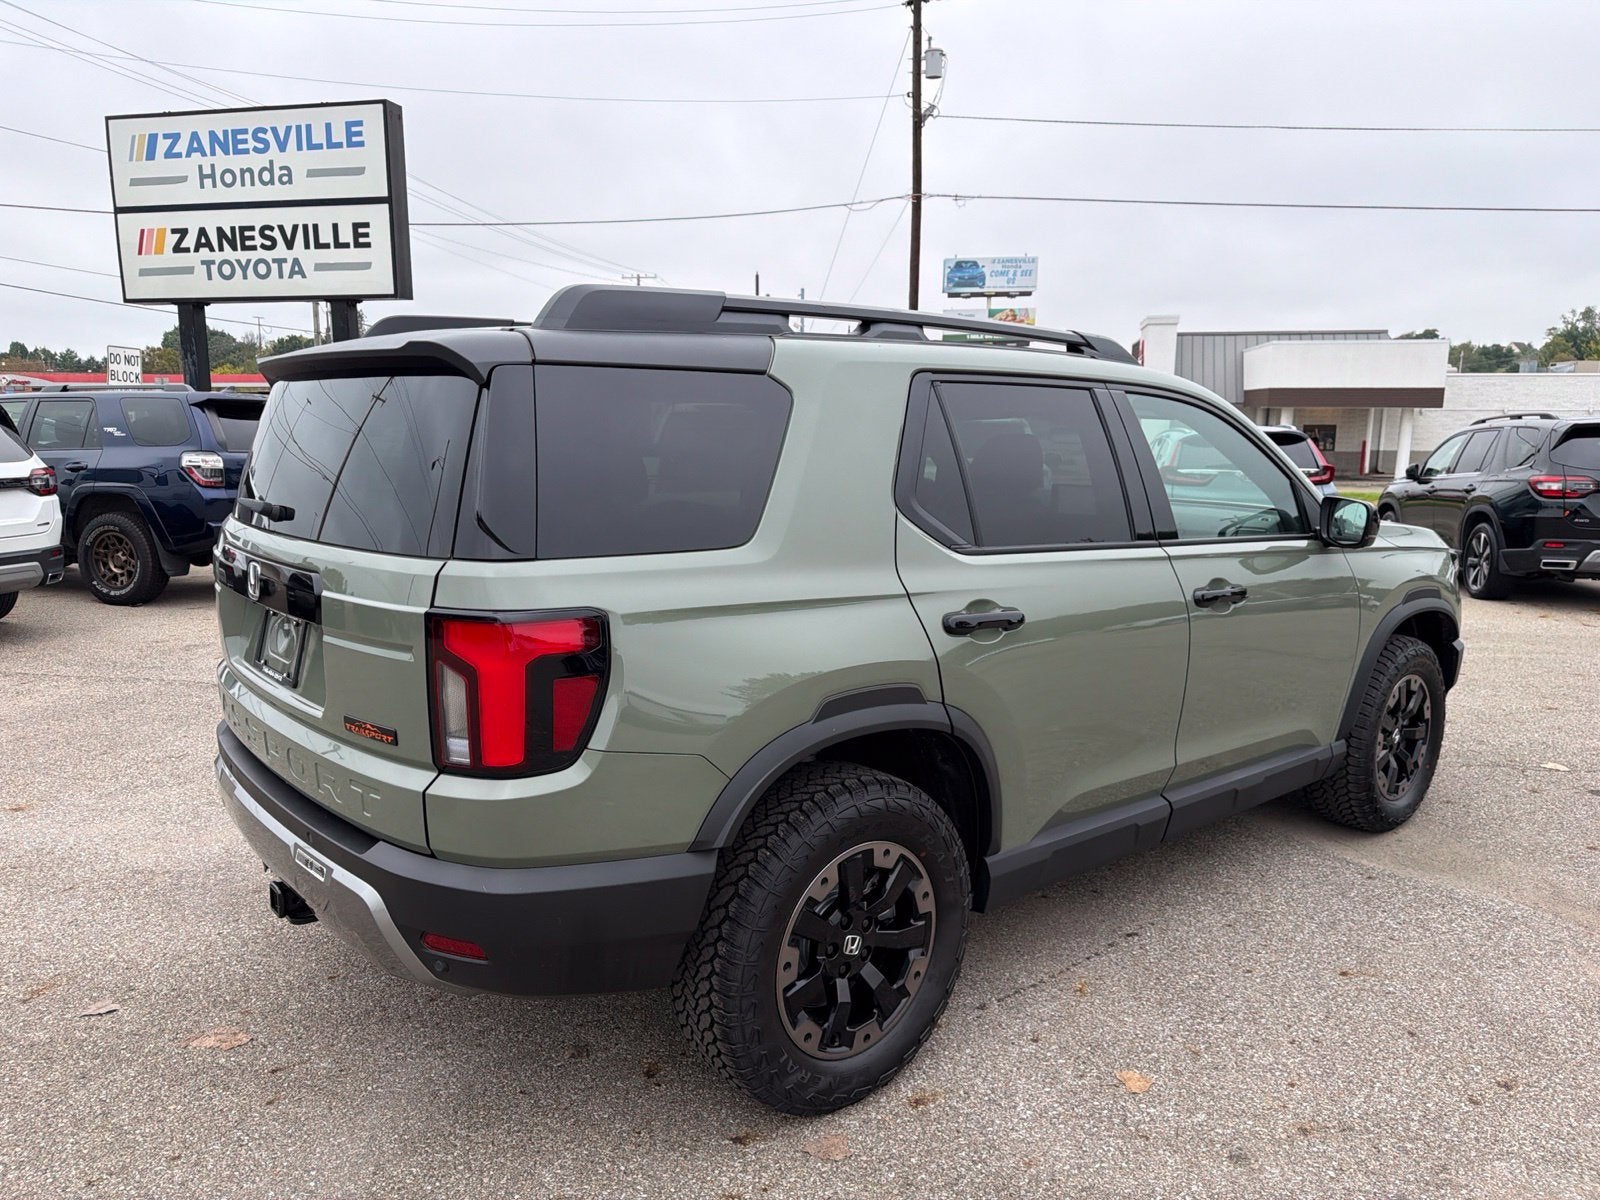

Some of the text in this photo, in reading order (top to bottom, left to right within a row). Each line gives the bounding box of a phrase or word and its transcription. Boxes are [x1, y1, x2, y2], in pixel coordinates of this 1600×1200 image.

[162, 120, 365, 160] ZANESVILLE
[197, 160, 293, 189] Honda
[170, 222, 372, 254] ZANESVILLE
[200, 257, 307, 281] TOYOTA
[110, 353, 140, 367] DO NOT
[110, 369, 141, 384] BLOCK
[222, 692, 383, 818] SSPORT
